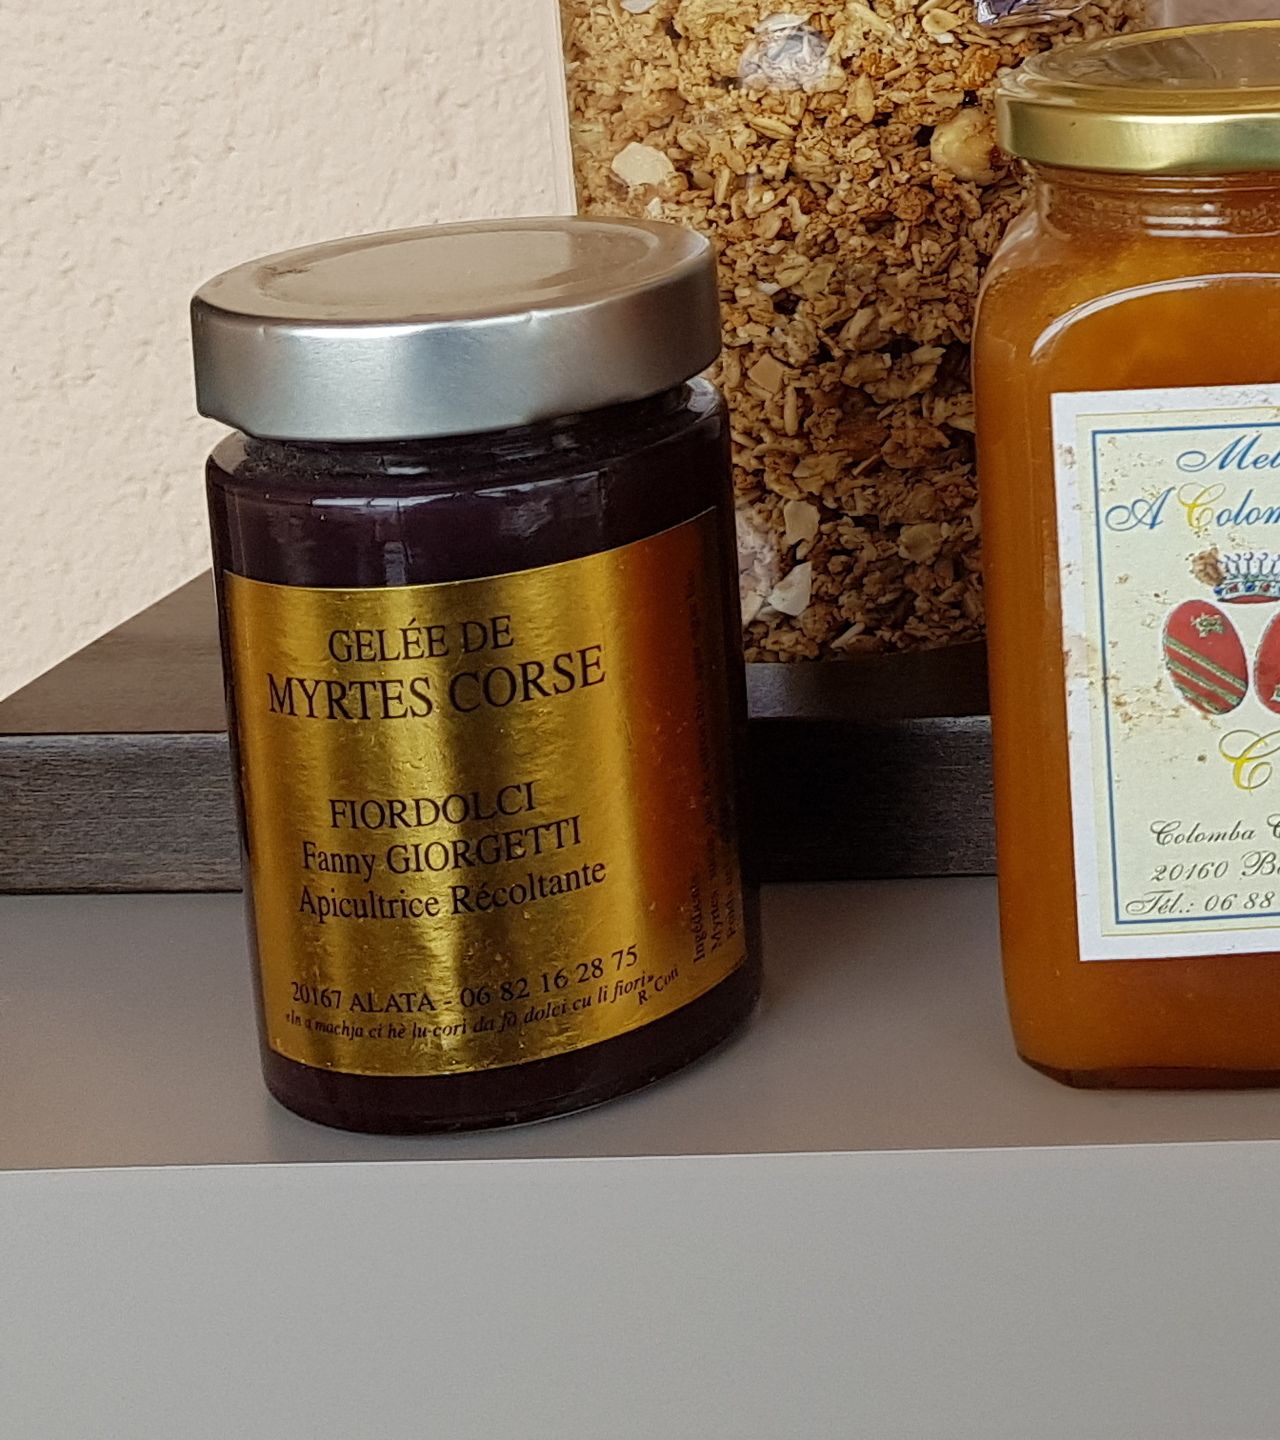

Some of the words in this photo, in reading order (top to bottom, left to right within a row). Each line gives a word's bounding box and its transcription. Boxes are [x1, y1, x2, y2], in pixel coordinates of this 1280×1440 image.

[1104, 485, 1177, 532] A
[328, 617, 450, 663] GELÉE
[463, 615, 515, 654] DE
[266, 672, 434, 721] MYRTES
[449, 644, 607, 714] CORSE
[329, 779, 540, 830] FIORDOLCI
[302, 840, 377, 883] Fanny
[387, 814, 582, 875] GIORGETTI
[1149, 819, 1256, 847] Colomba
[299, 885, 441, 924] Apicultrice
[451, 861, 608, 915] Récoltante
[1149, 860, 1230, 883] 20160
[1203, 893, 1238, 913] 06
[1243, 890, 1276, 910] 88
[291, 980, 342, 1009] 20167
[350, 991, 438, 1014] ALATA
[460, 986, 491, 1009] 06
[501, 977, 531, 1002] 82
[541, 967, 570, 994] 16
[576, 956, 605, 984] 28
[611, 944, 638, 972] 75
[524, 997, 568, 1025] dolci
